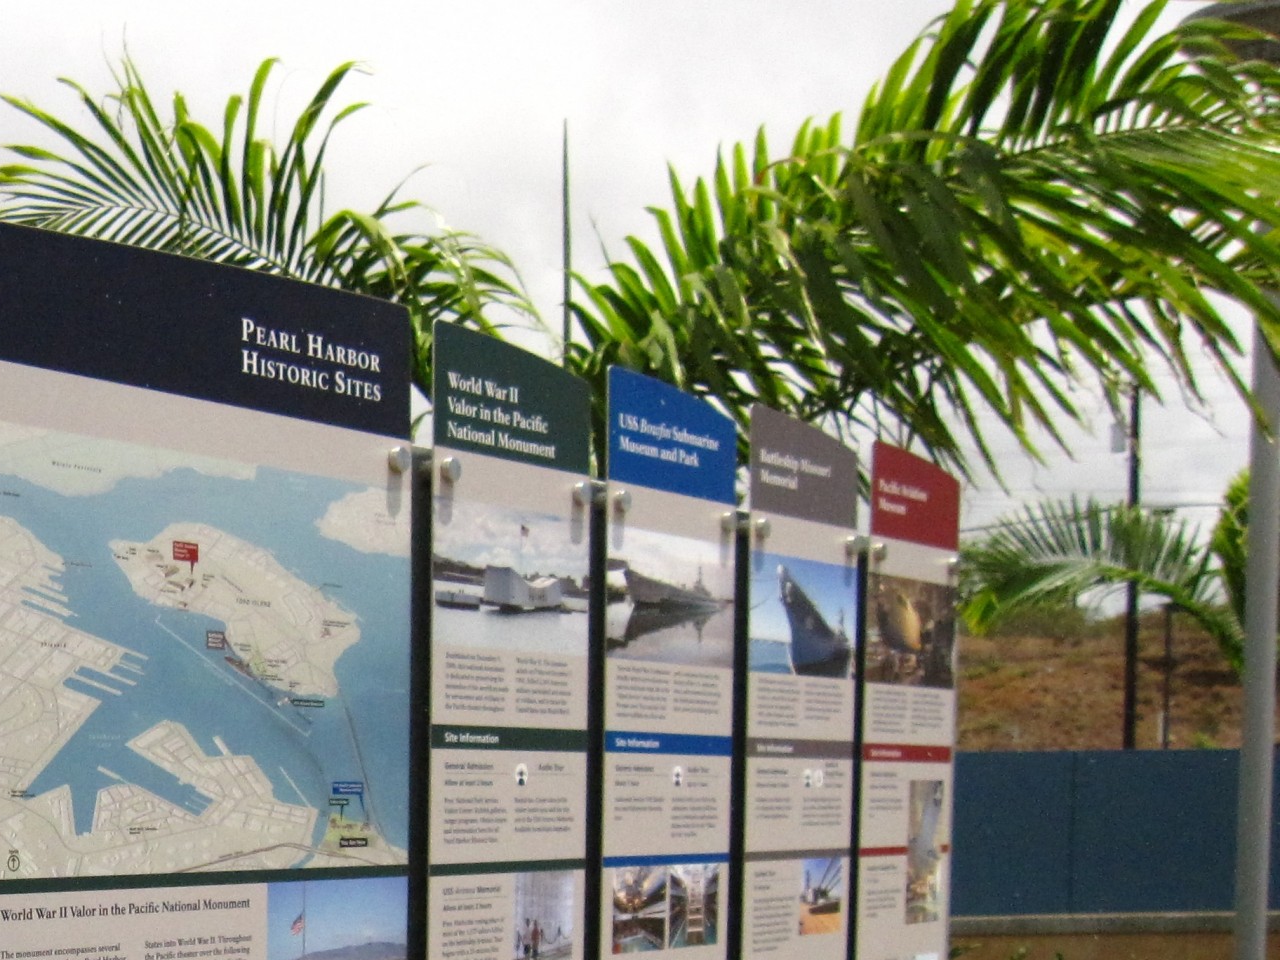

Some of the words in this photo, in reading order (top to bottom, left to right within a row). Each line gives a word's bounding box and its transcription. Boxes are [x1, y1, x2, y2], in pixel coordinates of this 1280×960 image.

[447, 372, 482, 394] World
[484, 380, 508, 400] War
[509, 386, 518, 403] II
[447, 396, 478, 417] Valor
[479, 403, 491, 421] in
[492, 407, 511, 425] the
[512, 411, 548, 433] Pacific
[447, 421, 495, 445] National
[497, 432, 555, 457] Monument
[444, 731, 459, 743] Site
[459, 733, 499, 745] Information
[0, 908, 33, 921] World
[35, 907, 57, 919] War
[59, 906, 67, 918] II
[69, 905, 97, 918] Valor
[98, 904, 108, 916] in
[110, 903, 126, 915] the
[128, 901, 159, 914] Pacific
[161, 899, 201, 912] National
[203, 899, 250, 910] Monument
